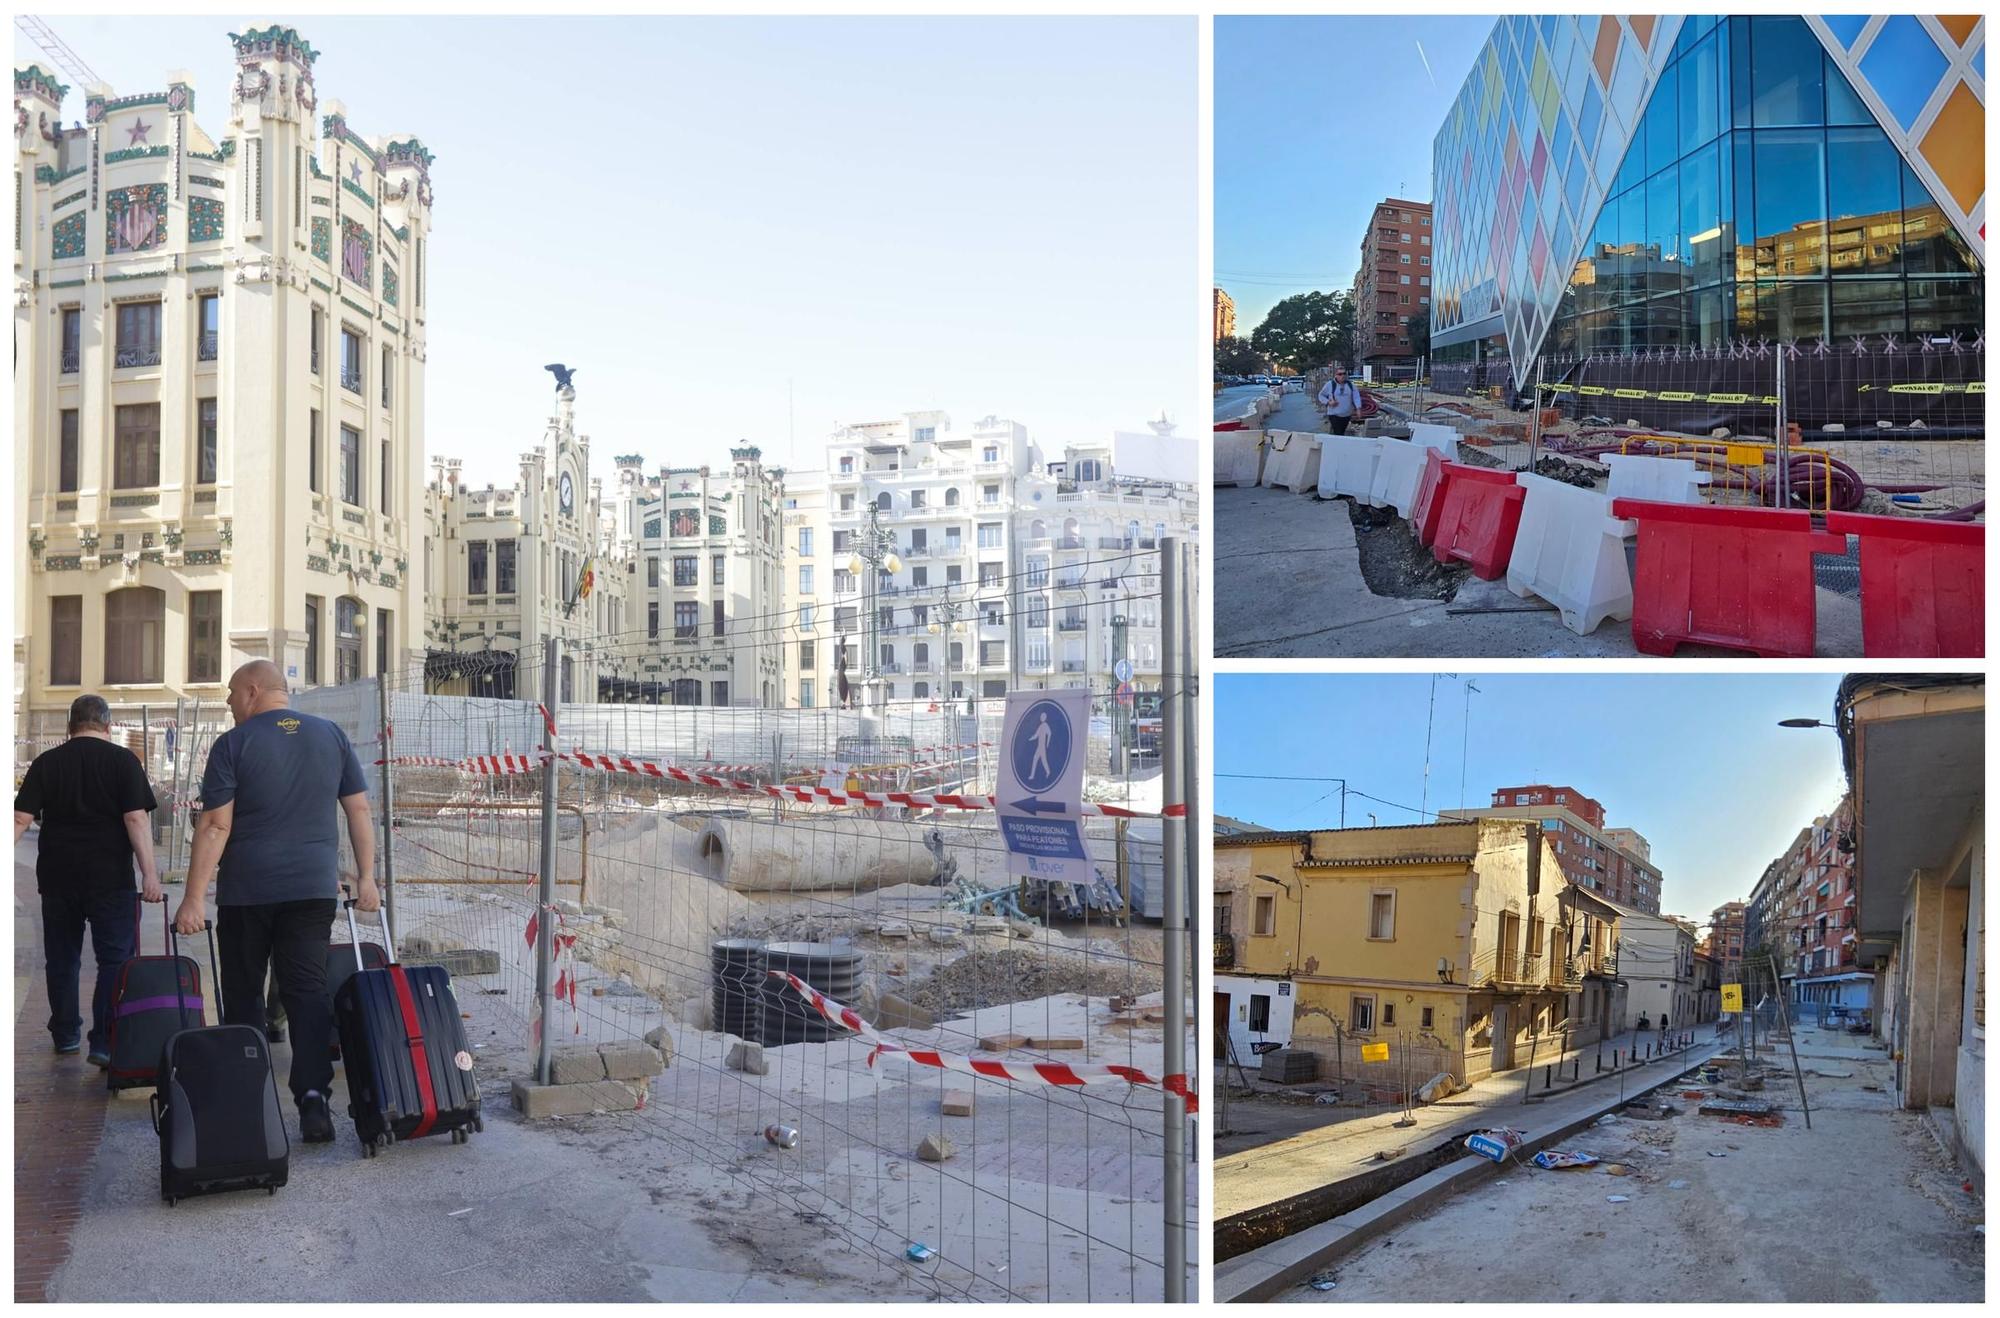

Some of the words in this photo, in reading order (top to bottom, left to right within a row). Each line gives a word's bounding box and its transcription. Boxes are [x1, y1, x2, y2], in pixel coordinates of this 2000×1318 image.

[1008, 822, 1025, 833] PASO
[1025, 824, 1071, 836] PROVISIONAL
[1015, 833, 1031, 842] PARA
[1031, 835, 1068, 845] PEATONES
